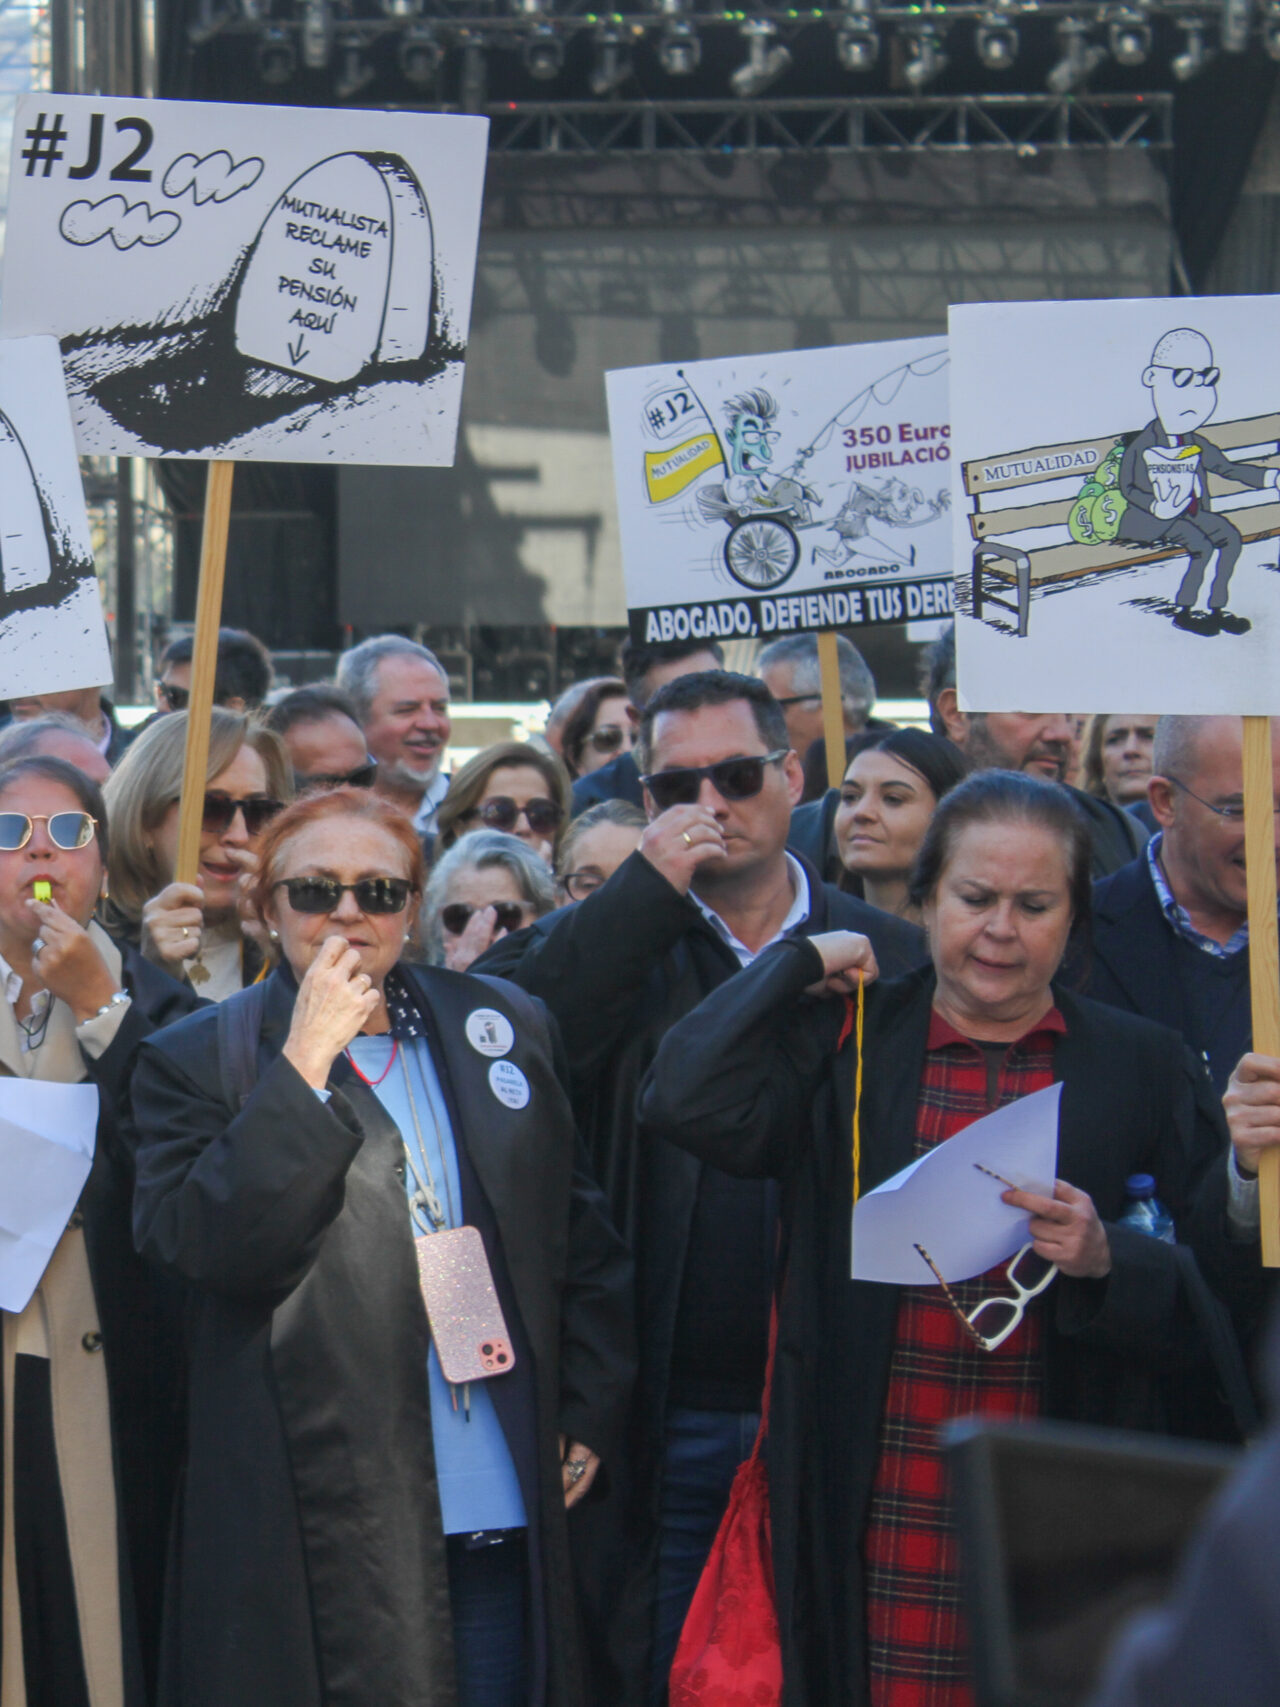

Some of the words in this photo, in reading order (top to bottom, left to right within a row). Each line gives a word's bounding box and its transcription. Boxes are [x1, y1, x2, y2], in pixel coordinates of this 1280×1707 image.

[21, 113, 154, 183] #J2
[280, 194, 389, 238] MUTUALISTA
[285, 222, 371, 258] RECLAME
[308, 257, 337, 280] SU
[278, 275, 358, 312] PENSIÓN
[288, 307, 338, 334] AQUÍ
[649, 392, 695, 430] #J2
[843, 425, 892, 448] 350
[651, 440, 710, 478] MUTUALIDAD
[984, 450, 1098, 482] MUTUALIDAD
[645, 602, 758, 643] ABOGADO,
[761, 587, 863, 633] DEFIENDE
[864, 586, 902, 622] TUS
